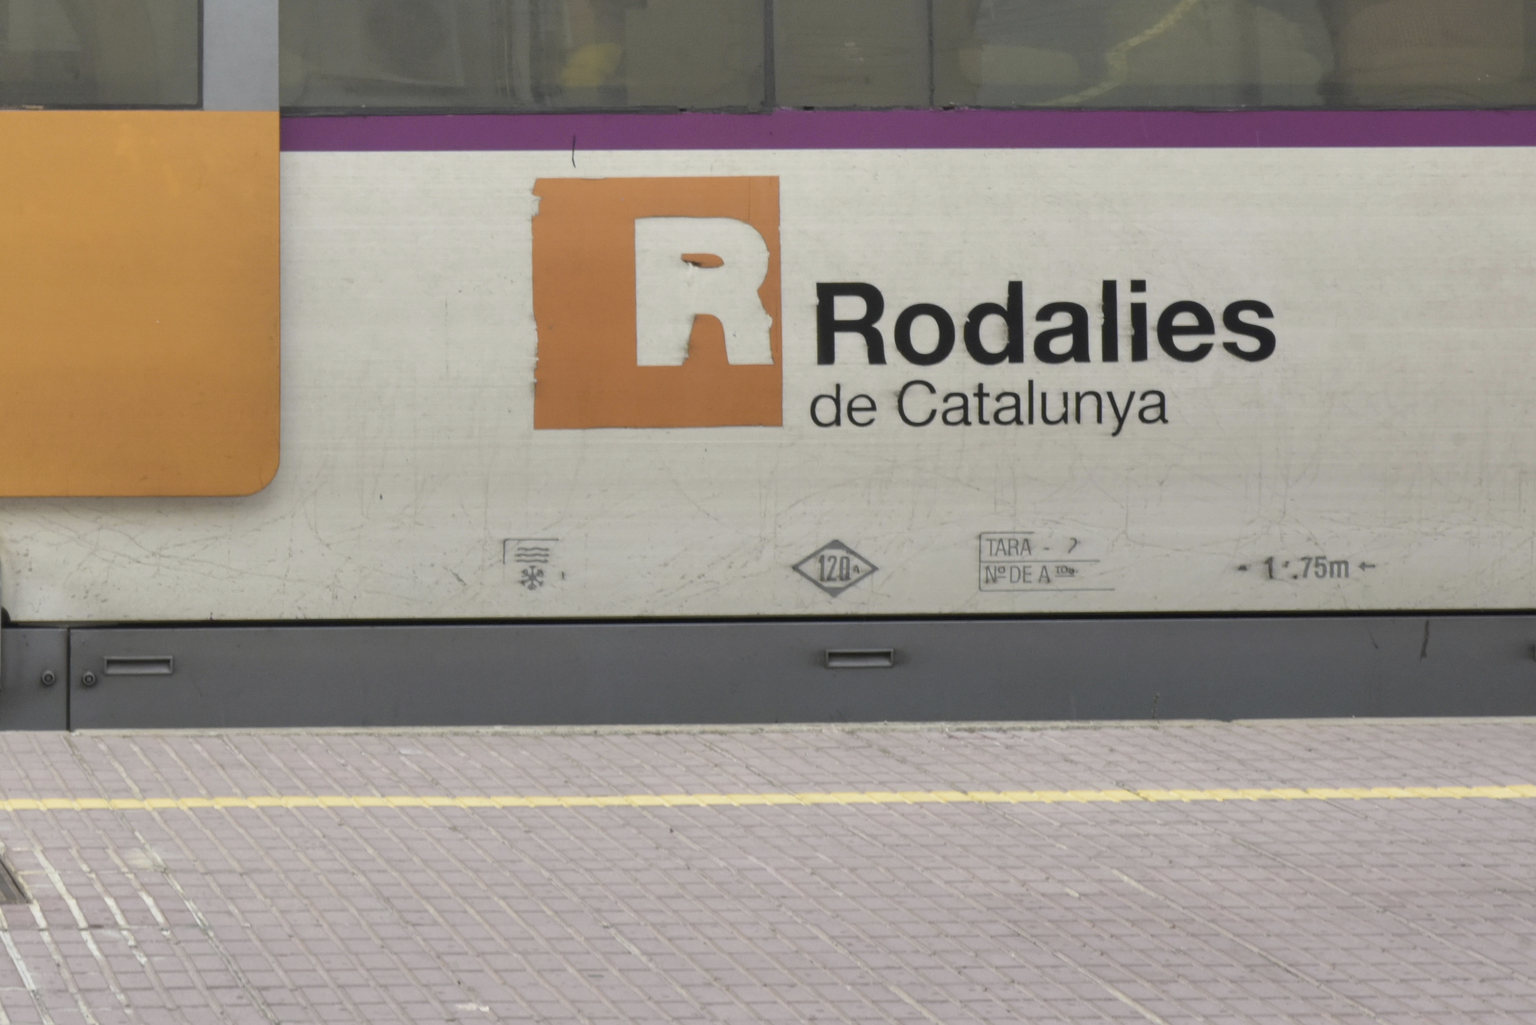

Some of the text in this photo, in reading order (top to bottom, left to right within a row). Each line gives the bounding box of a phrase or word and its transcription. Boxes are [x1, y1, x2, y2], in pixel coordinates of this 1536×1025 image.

[634, 216, 775, 366] R
[815, 279, 1277, 366] Rodalies
[810, 379, 1169, 437] de Catalunya
[818, 554, 851, 582] 120
[985, 538, 1032, 556] TARA
[1009, 565, 1032, 584] DE
